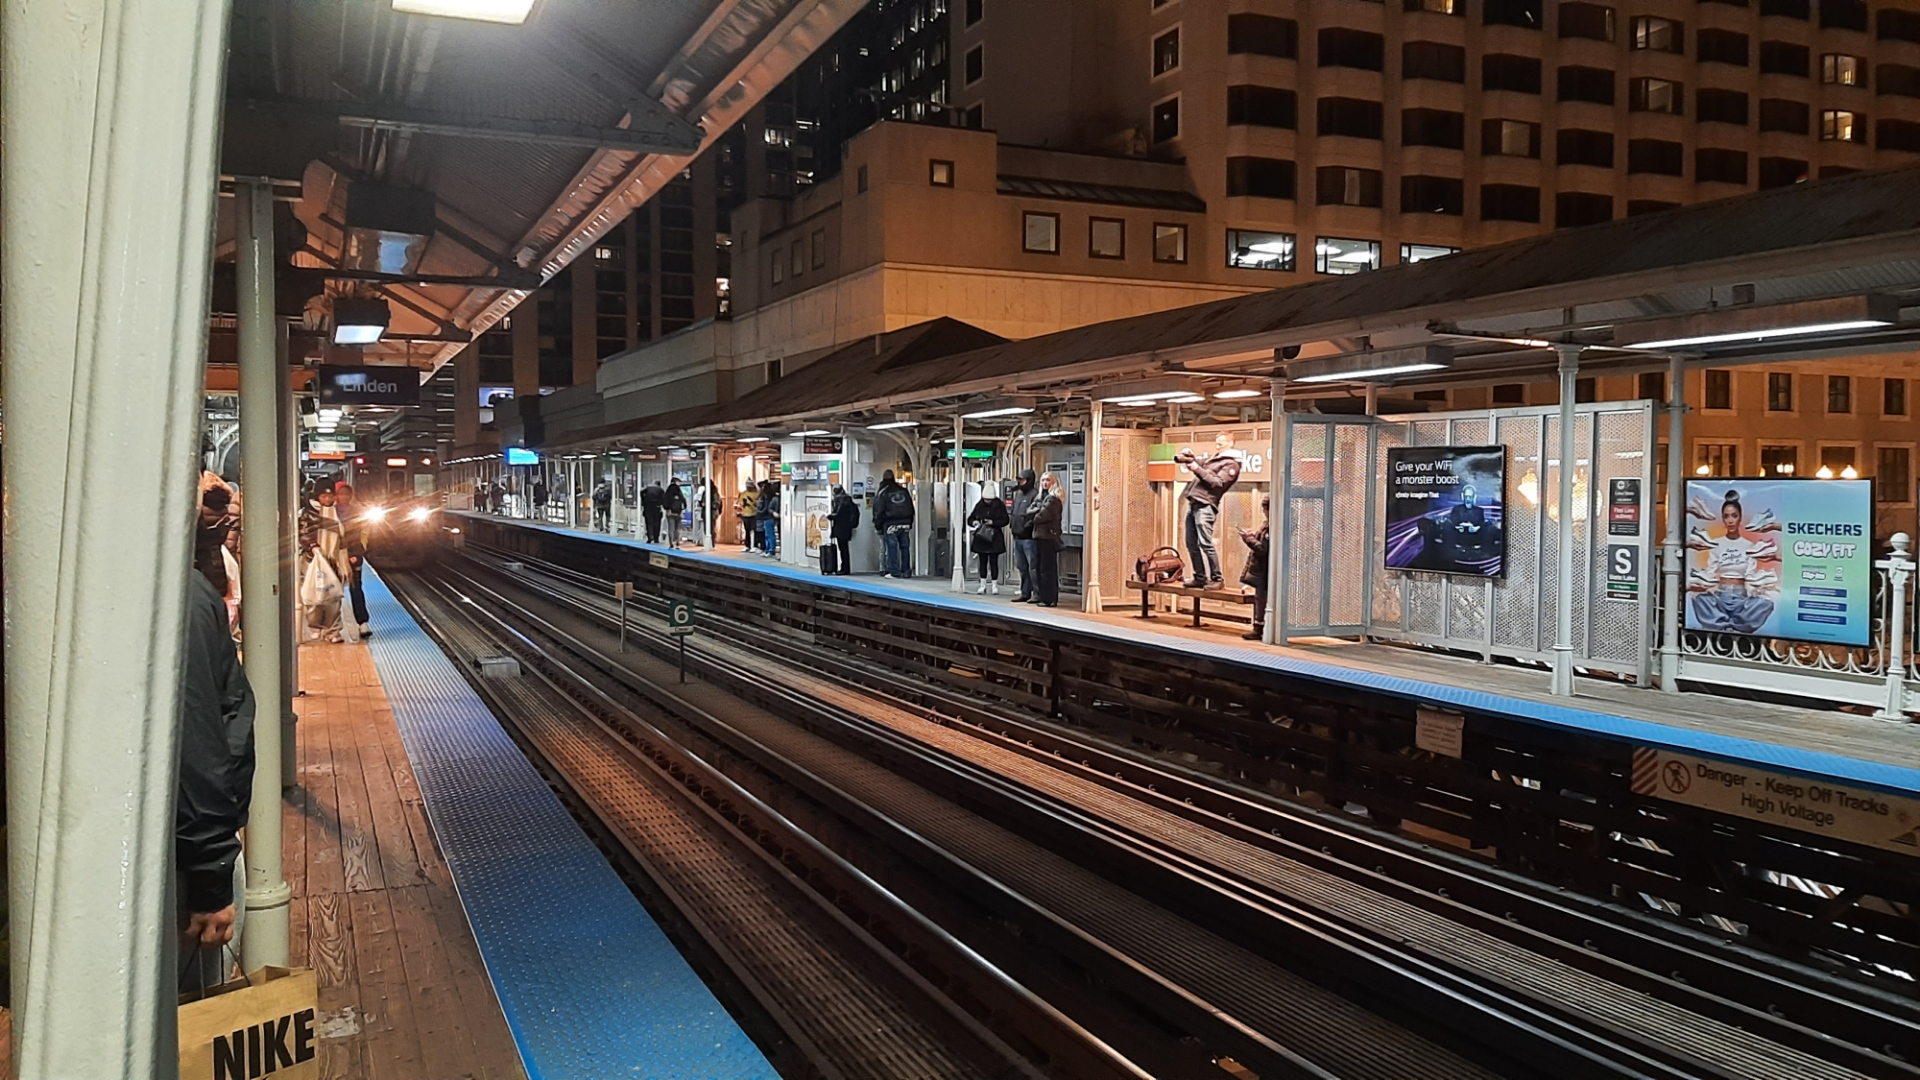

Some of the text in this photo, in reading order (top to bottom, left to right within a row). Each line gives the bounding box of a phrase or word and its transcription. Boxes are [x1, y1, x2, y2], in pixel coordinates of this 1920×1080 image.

[1395, 460, 1453, 474] Give your WiFi
[1395, 474, 1459, 485] a monster boost
[1787, 522, 1862, 537] SKECHERS
[1794, 540, 1857, 559] COZY FIT
[1615, 548, 1632, 574] S
[674, 604, 689, 624] 6
[1696, 763, 1747, 788] Danger
[1765, 777, 1804, 799] Keep
[1808, 785, 1833, 804] Off
[1835, 791, 1889, 816] Tracks
[1741, 792, 1834, 827] High Voltage
[213, 1008, 316, 1080] NIKE
